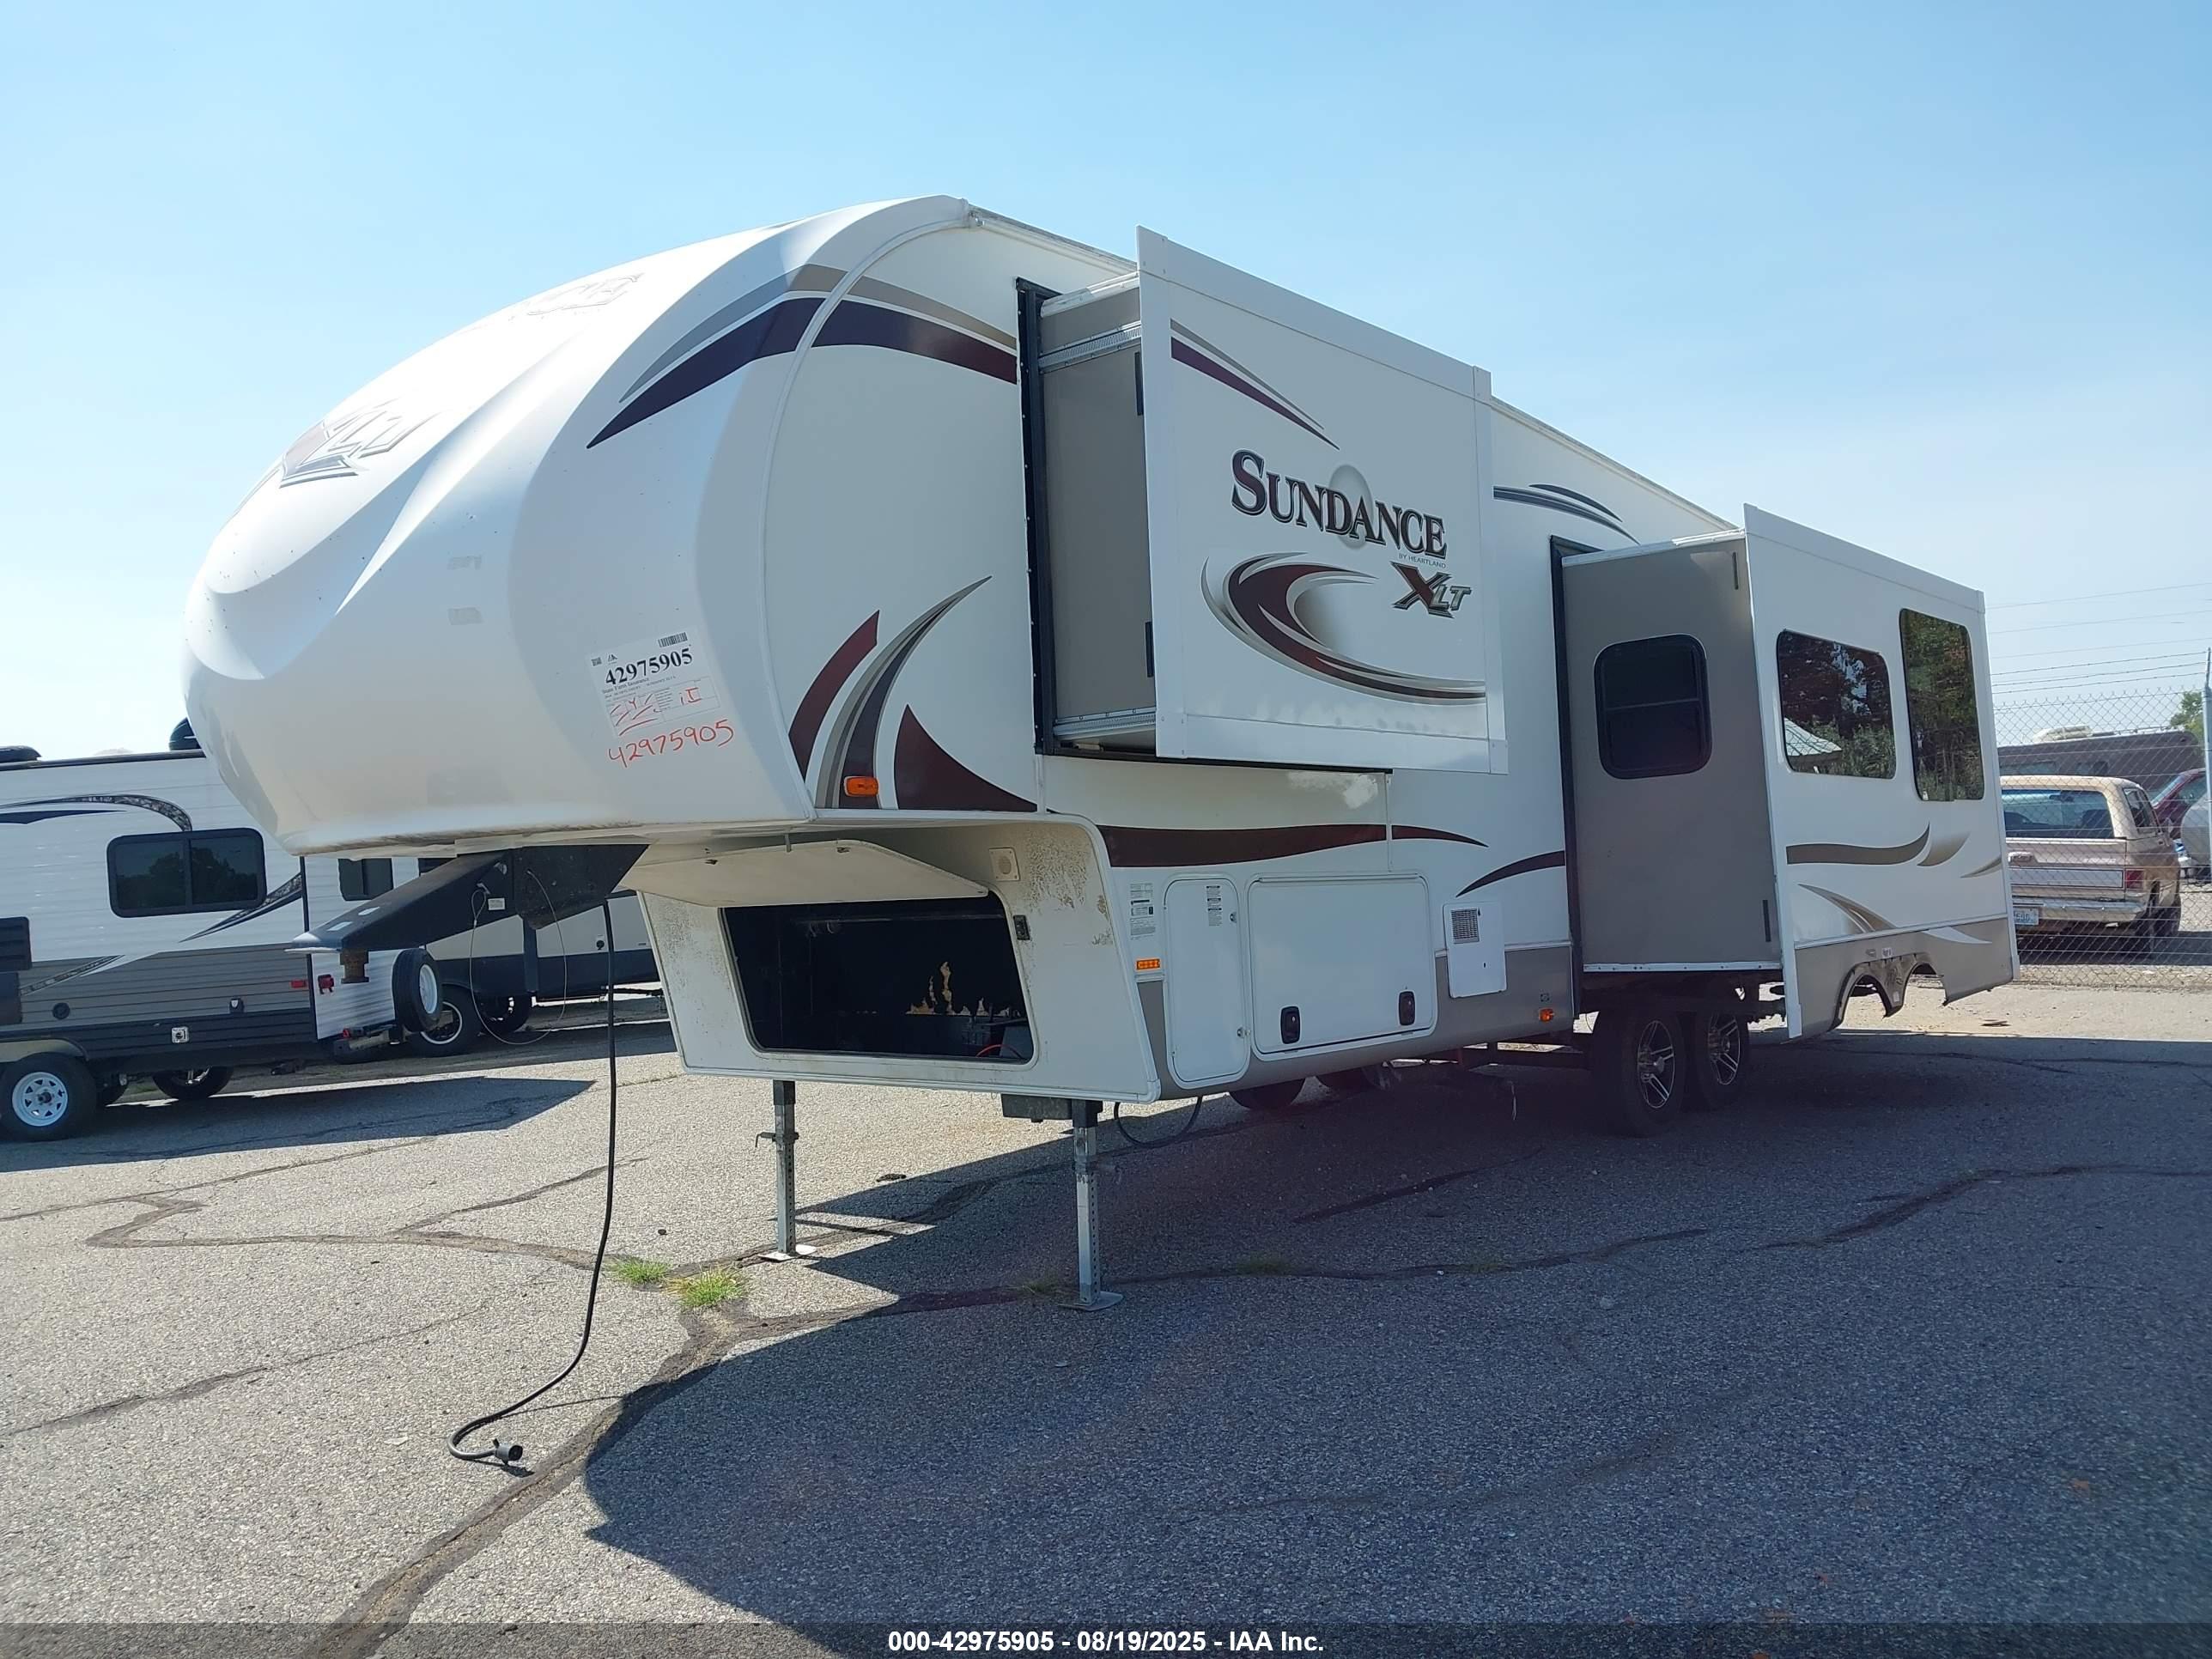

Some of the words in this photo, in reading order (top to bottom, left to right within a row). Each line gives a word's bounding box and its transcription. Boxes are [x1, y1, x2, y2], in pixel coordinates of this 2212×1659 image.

[1231, 448, 1447, 559] SUNDANCE
[1408, 556, 1446, 568] HEARTLAND
[1389, 560, 1472, 619] XLT
[605, 647, 693, 685] 42975905
[608, 719, 734, 769] 42975905
